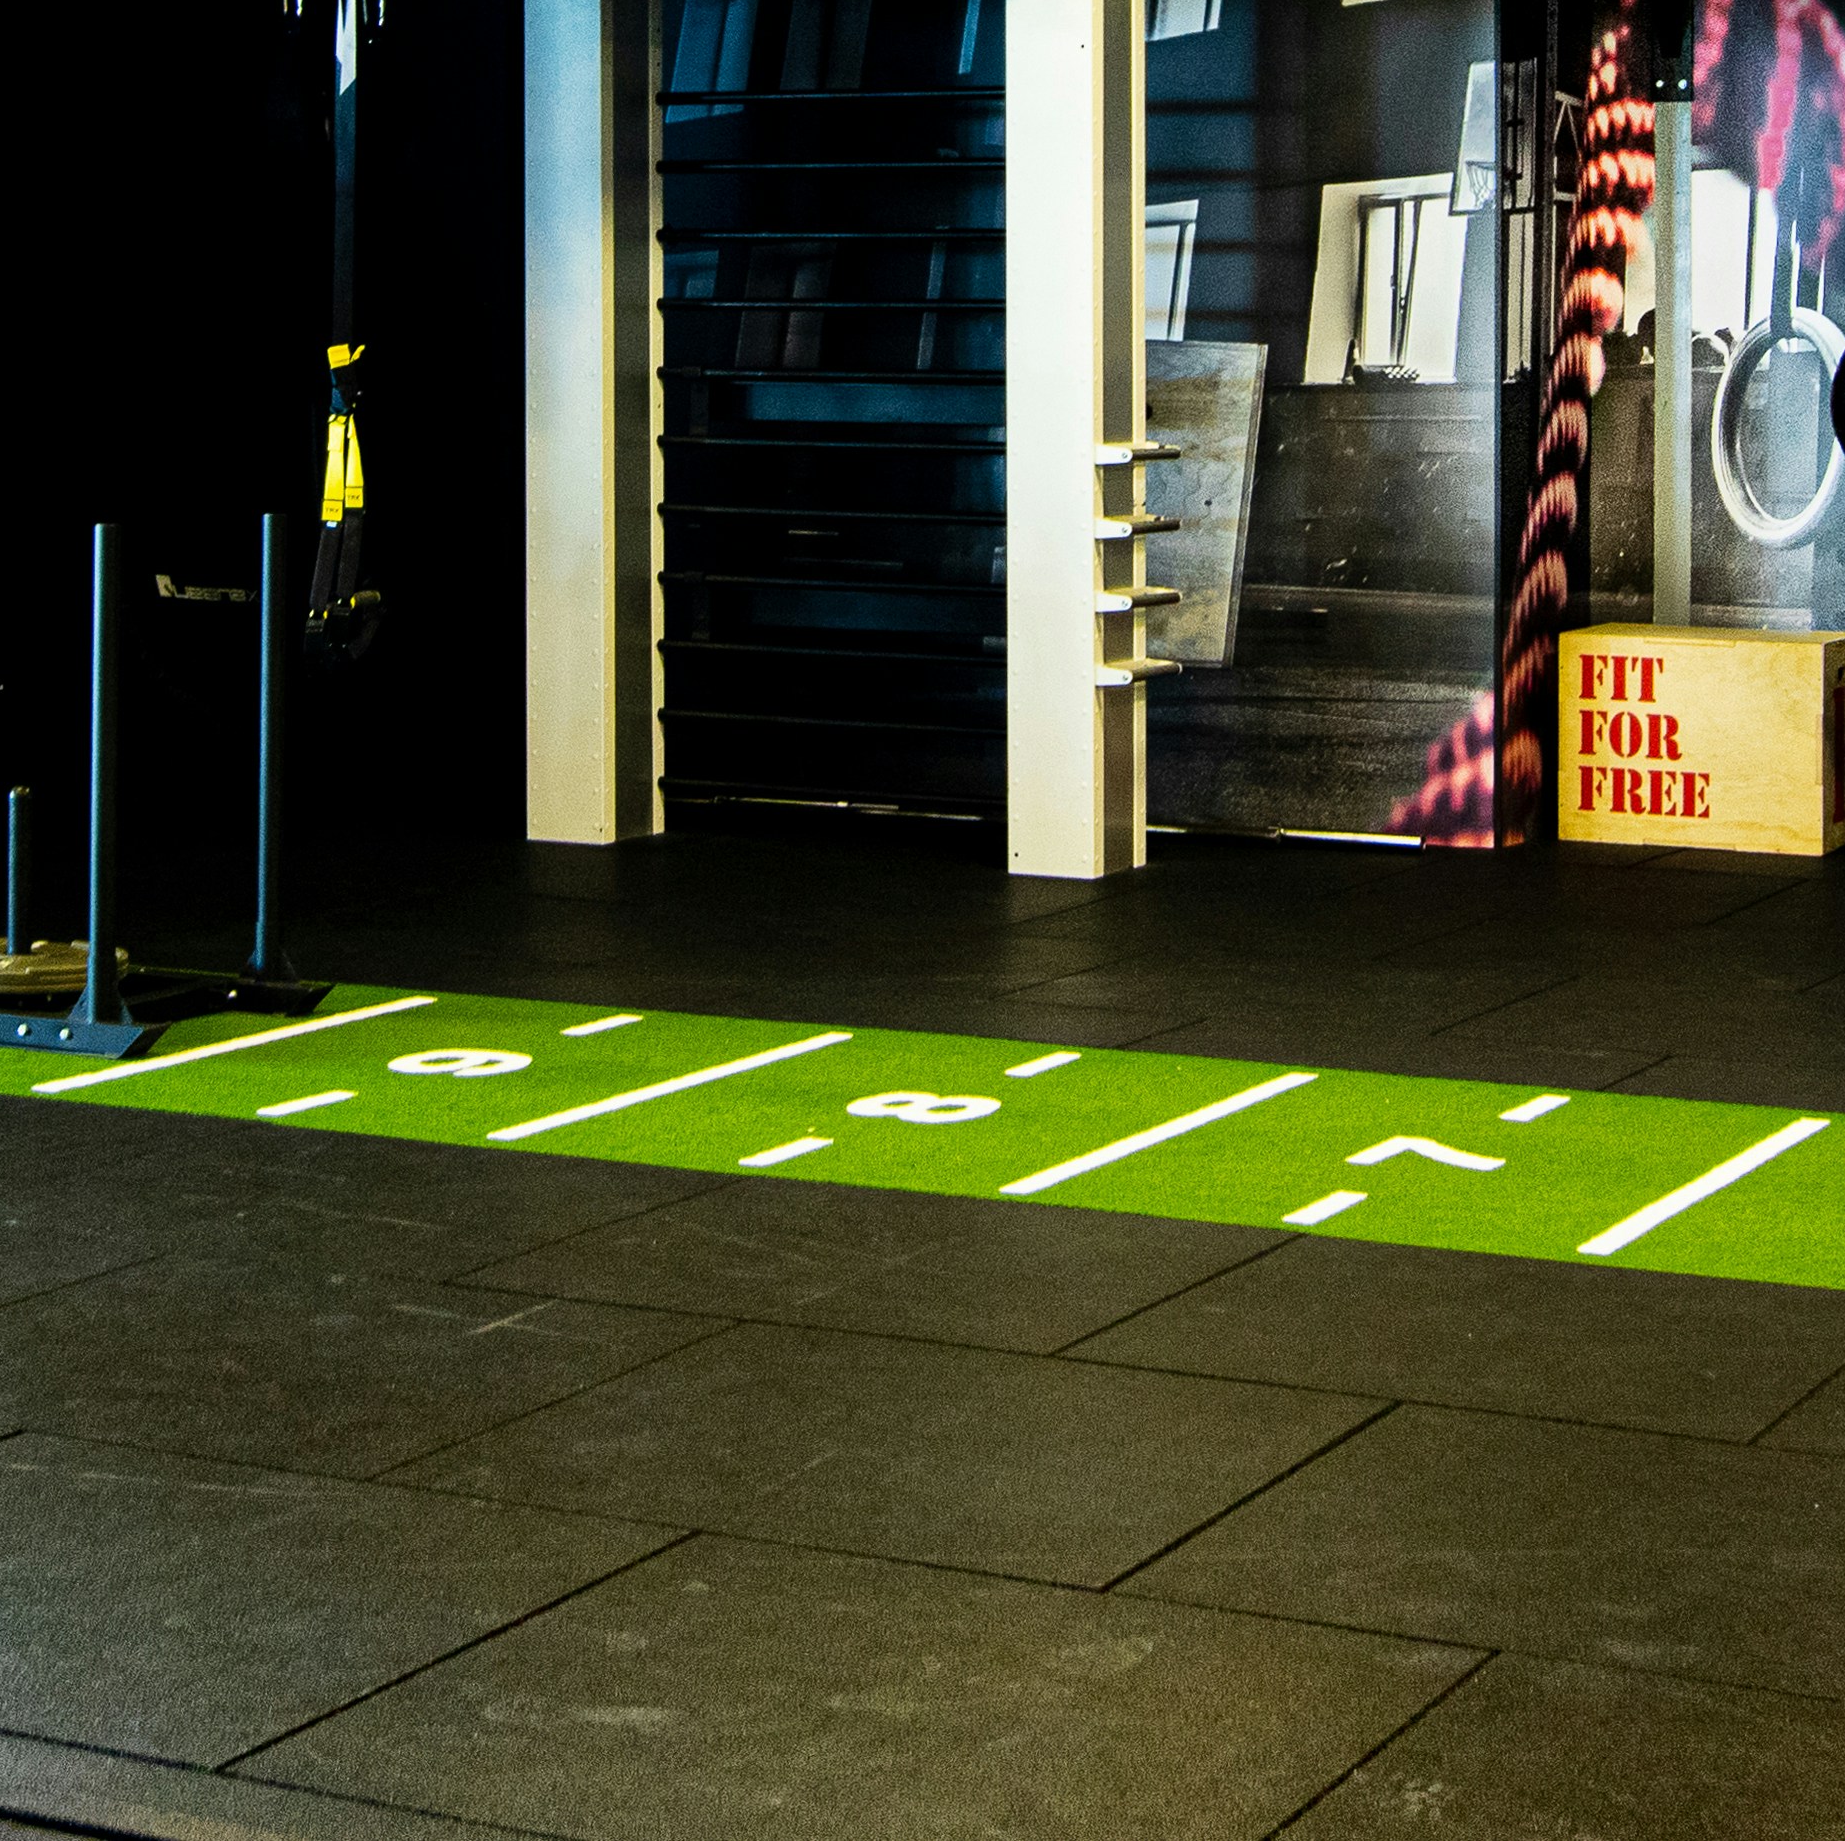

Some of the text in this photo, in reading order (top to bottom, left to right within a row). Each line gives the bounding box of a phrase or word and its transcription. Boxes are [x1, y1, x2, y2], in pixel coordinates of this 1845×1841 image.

[1579, 654, 1664, 702] FIT
[1578, 709, 1682, 761] FOR
[1578, 765, 1710, 818] FREE
[387, 1048, 533, 1079] 9
[846, 1091, 1001, 1125] 8
[1346, 1135, 1506, 1172] 7
